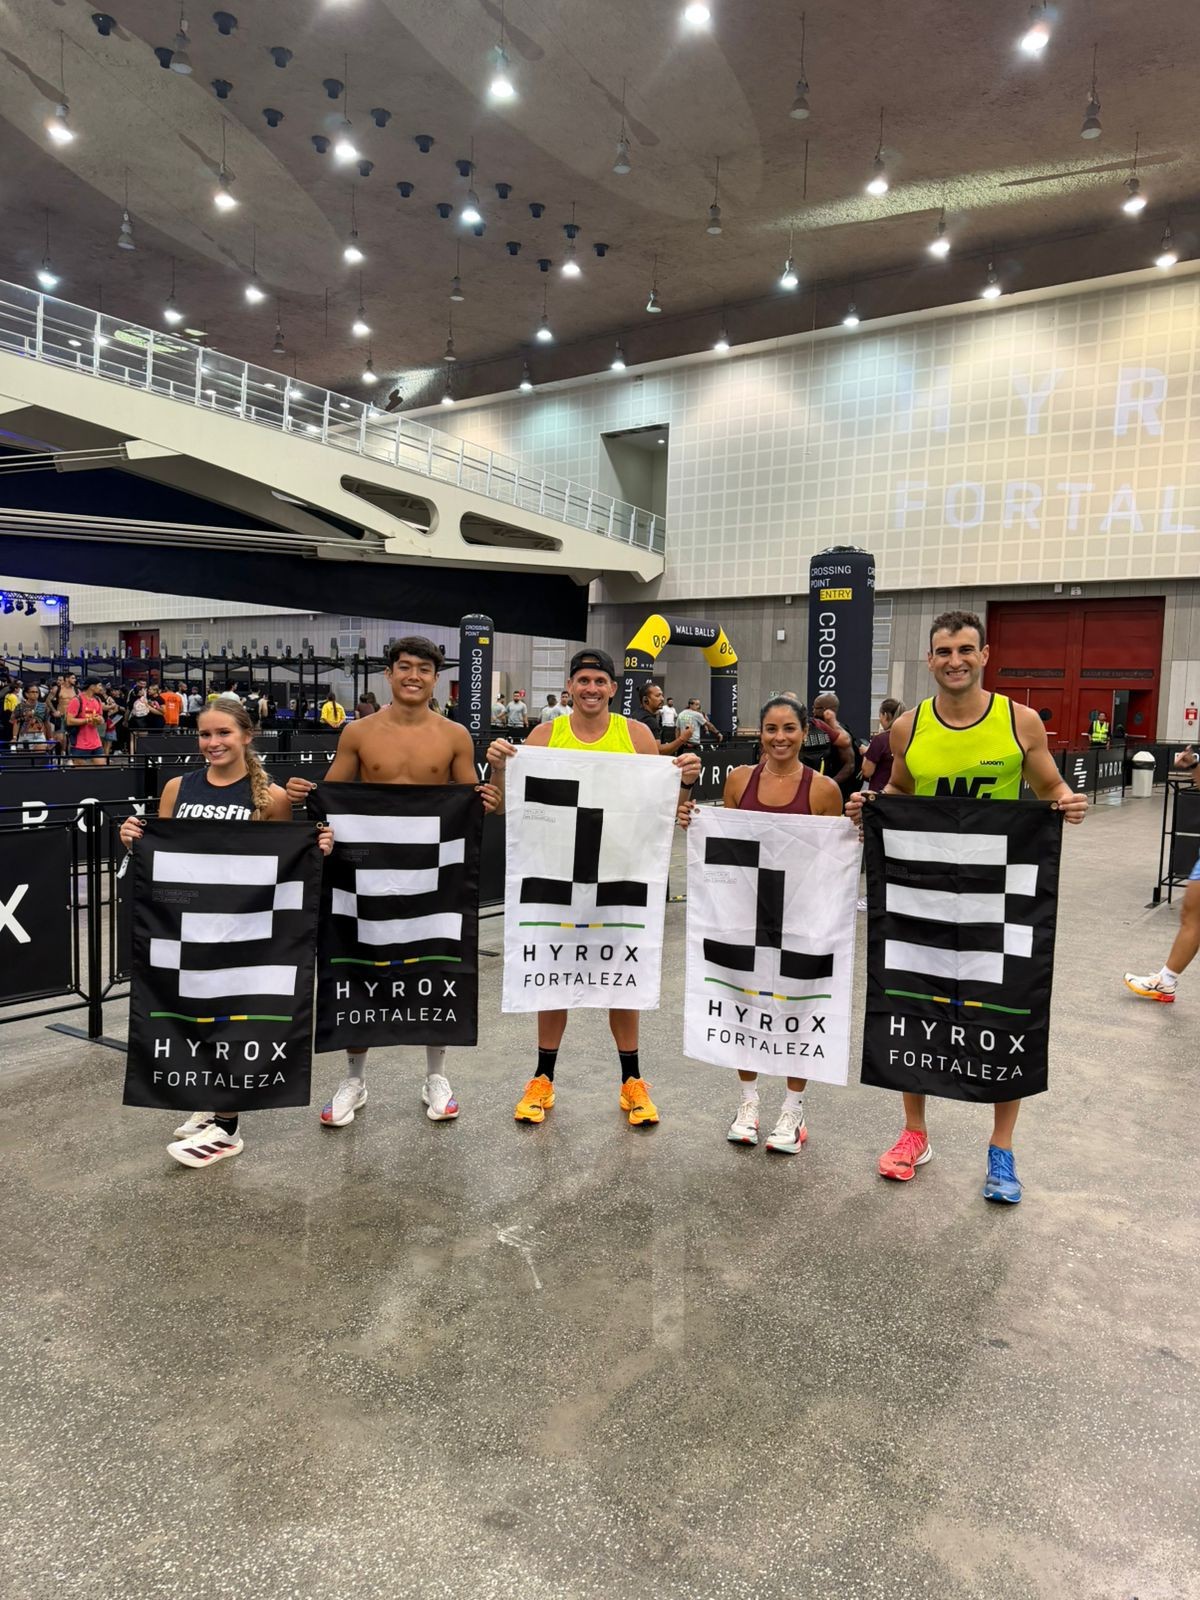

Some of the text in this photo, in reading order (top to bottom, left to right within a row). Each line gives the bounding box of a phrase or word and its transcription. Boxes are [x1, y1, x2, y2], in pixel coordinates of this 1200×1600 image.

[810, 565, 852, 577] CROSSING
[810, 578, 831, 588] POINT
[820, 590, 852, 600] ENTRY
[675, 624, 716, 638] WALL BALLS
[652, 634, 667, 648] 08
[625, 656, 638, 668] 08
[471, 648, 483, 710] CROSSING
[623, 678, 634, 715] BALLS
[1098, 761, 1122, 778] HYROX
[523, 944, 639, 963] HYROX
[336, 978, 457, 1000] HYROX
[523, 972, 637, 988] FORTALEZA
[336, 1007, 457, 1026] FORTALEZA
[708, 999, 826, 1034] HYROX
[707, 1028, 825, 1059] FORTALEZA
[889, 1015, 1026, 1054] HYROX
[154, 1038, 287, 1061] HYROX
[889, 1050, 1024, 1082] FORTALEZA
[153, 1071, 286, 1089] FORTALEZA
